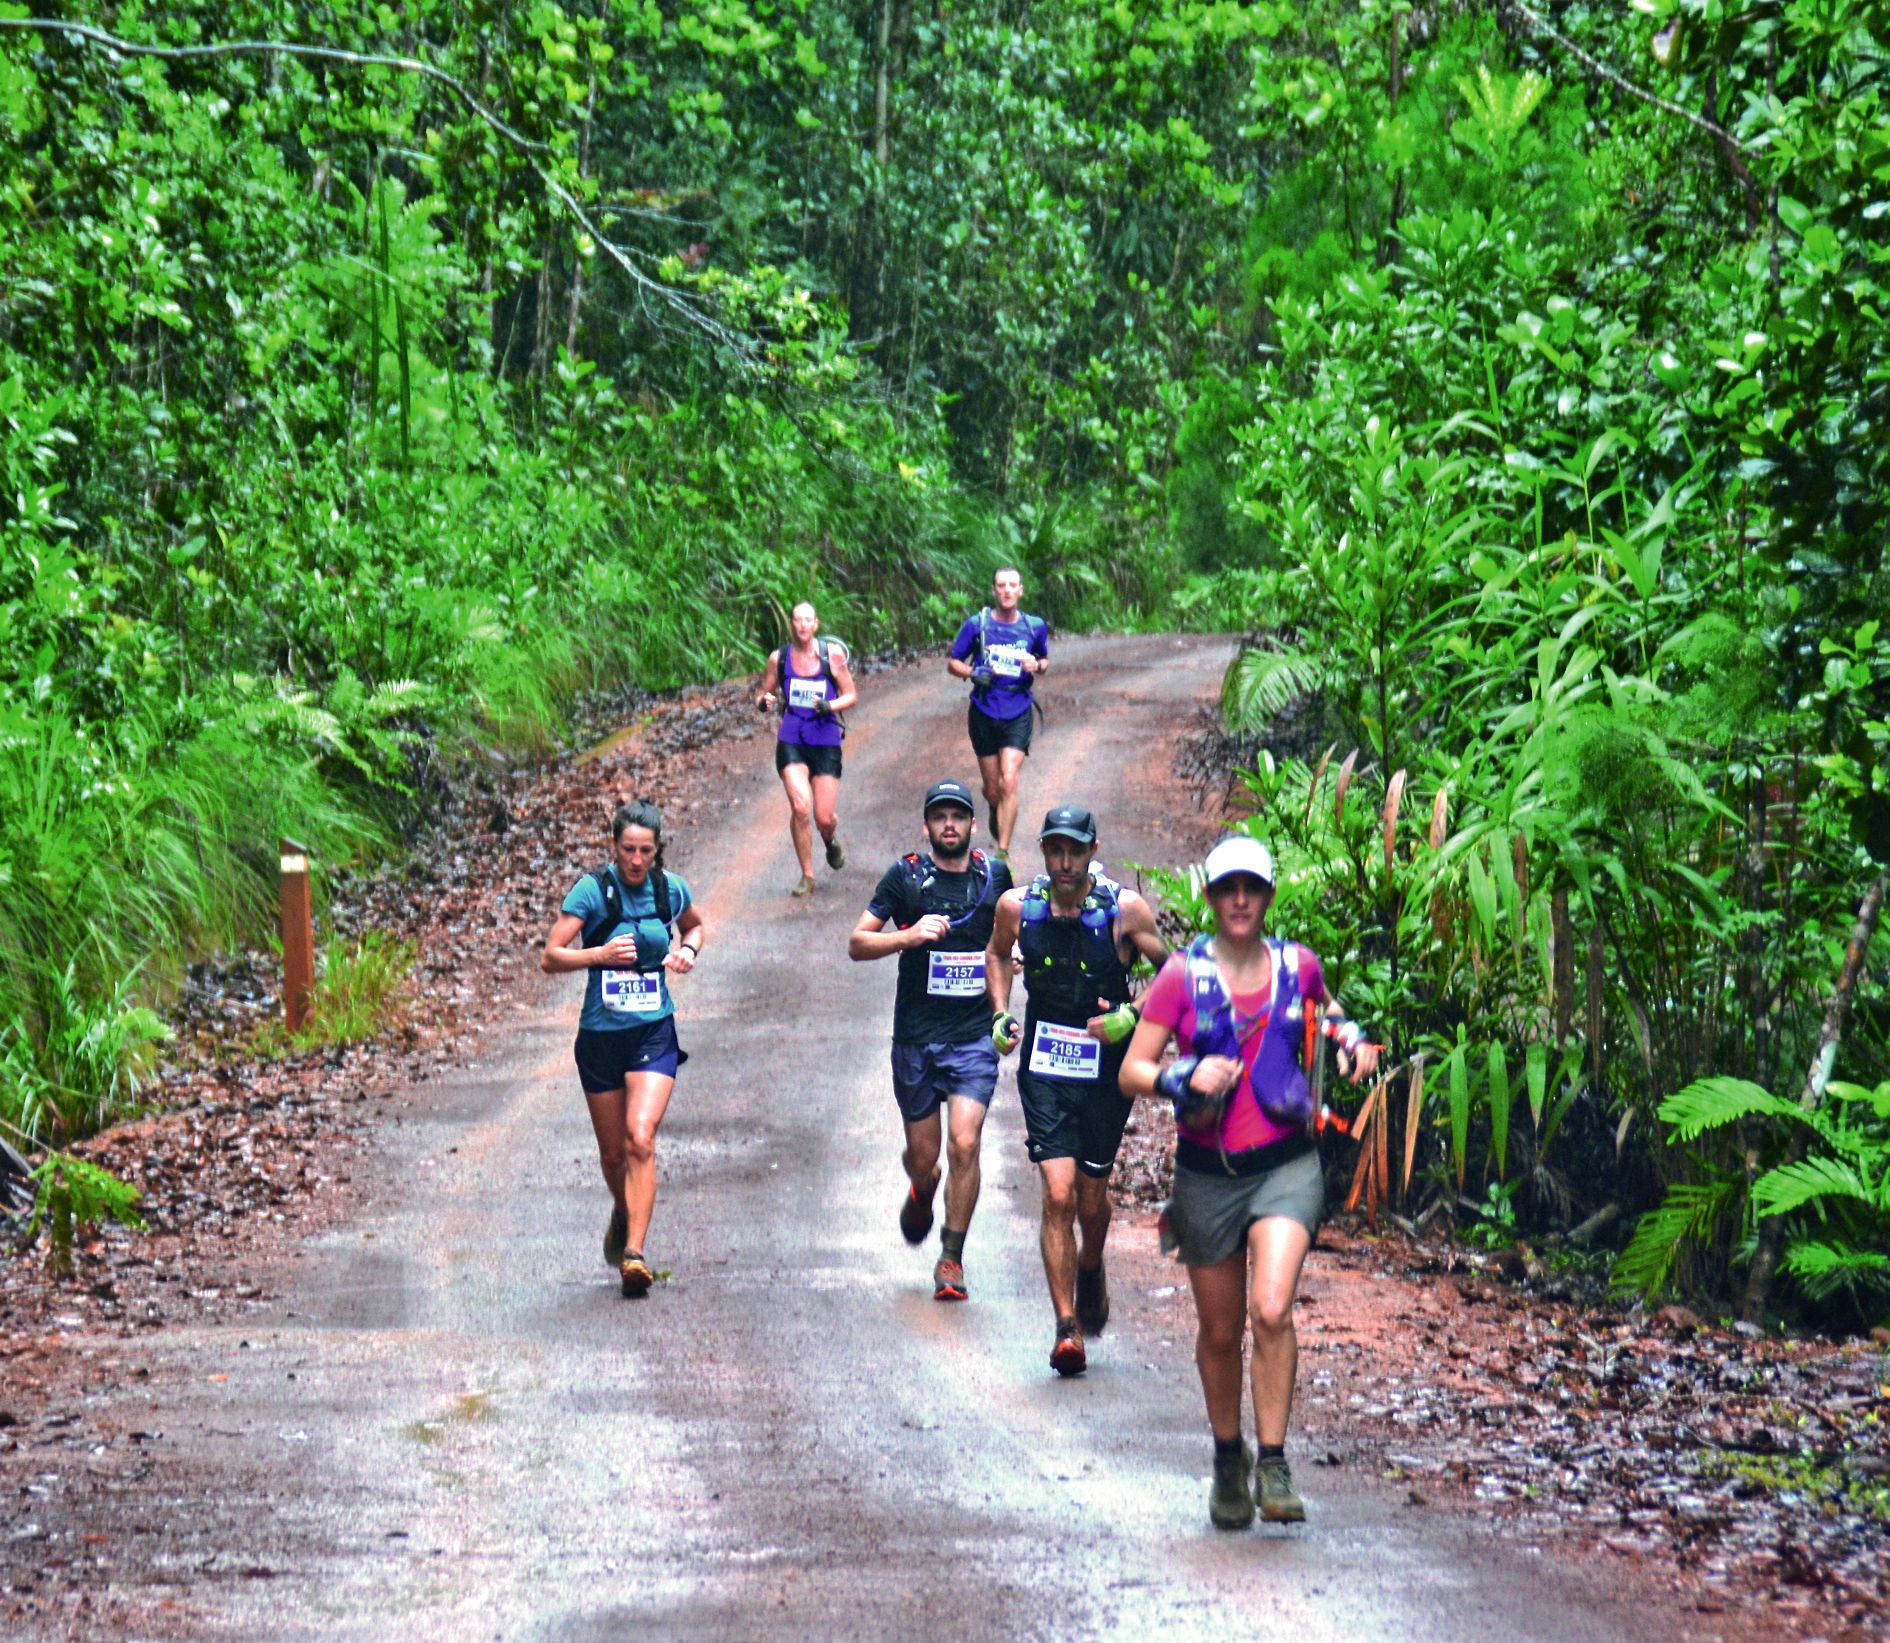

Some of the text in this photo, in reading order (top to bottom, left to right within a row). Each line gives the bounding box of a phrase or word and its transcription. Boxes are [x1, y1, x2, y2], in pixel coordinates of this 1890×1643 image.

[945, 966, 975, 978] 2157
[618, 980, 646, 993] 2161
[1050, 1040, 1082, 1058] 2185
